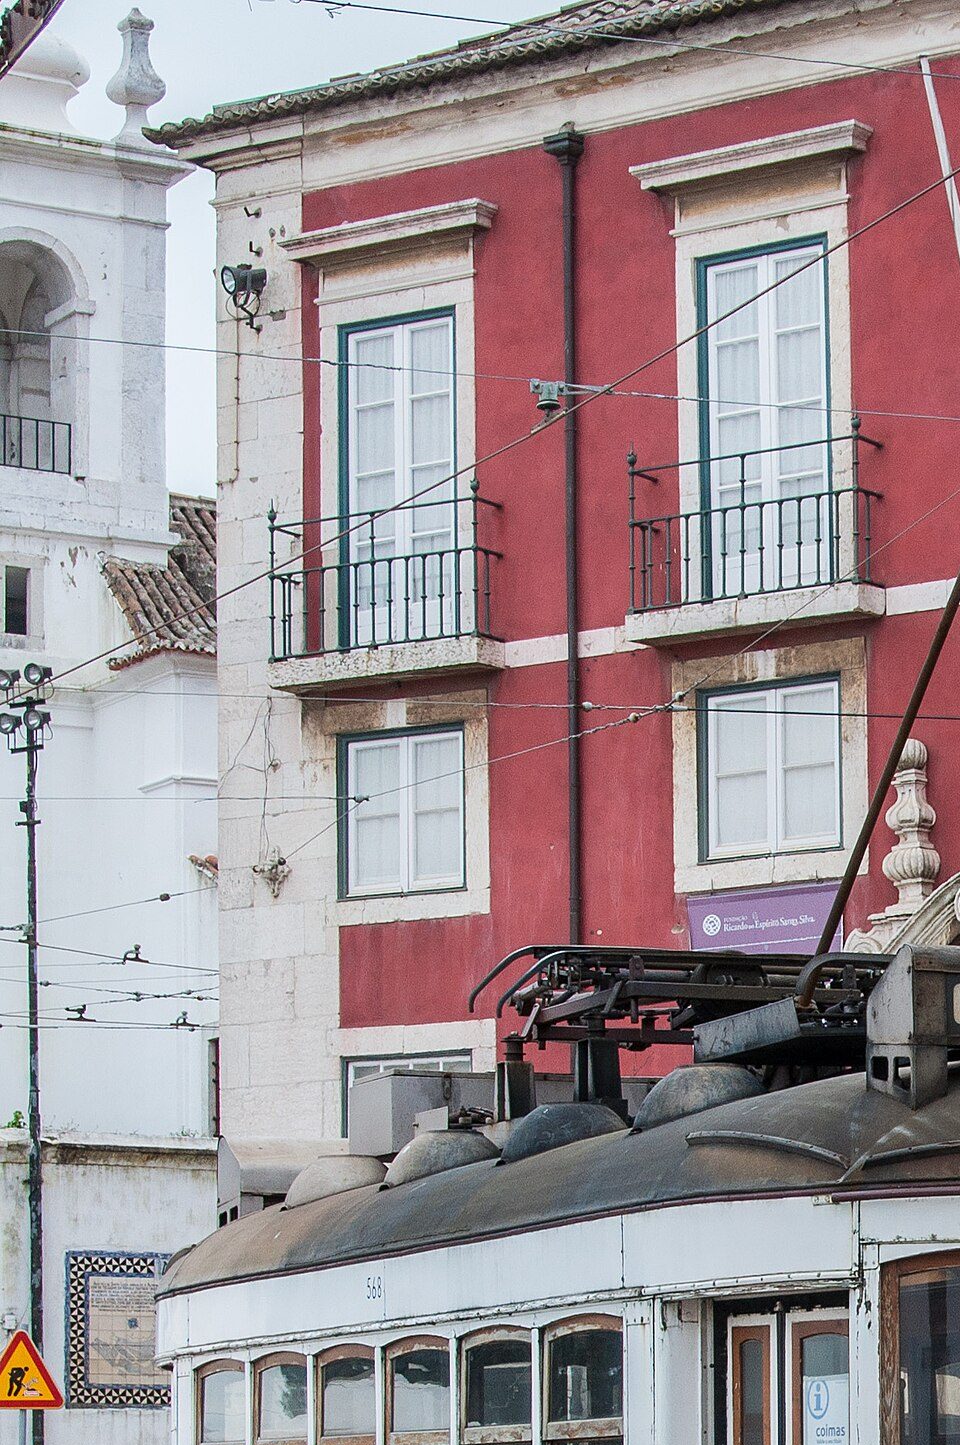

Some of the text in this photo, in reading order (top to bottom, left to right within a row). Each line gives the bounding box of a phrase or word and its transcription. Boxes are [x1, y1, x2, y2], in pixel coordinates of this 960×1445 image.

[723, 921, 748, 931] Ricardo
[366, 1276, 382, 1299] 568
[815, 1423, 846, 1438] coimas
